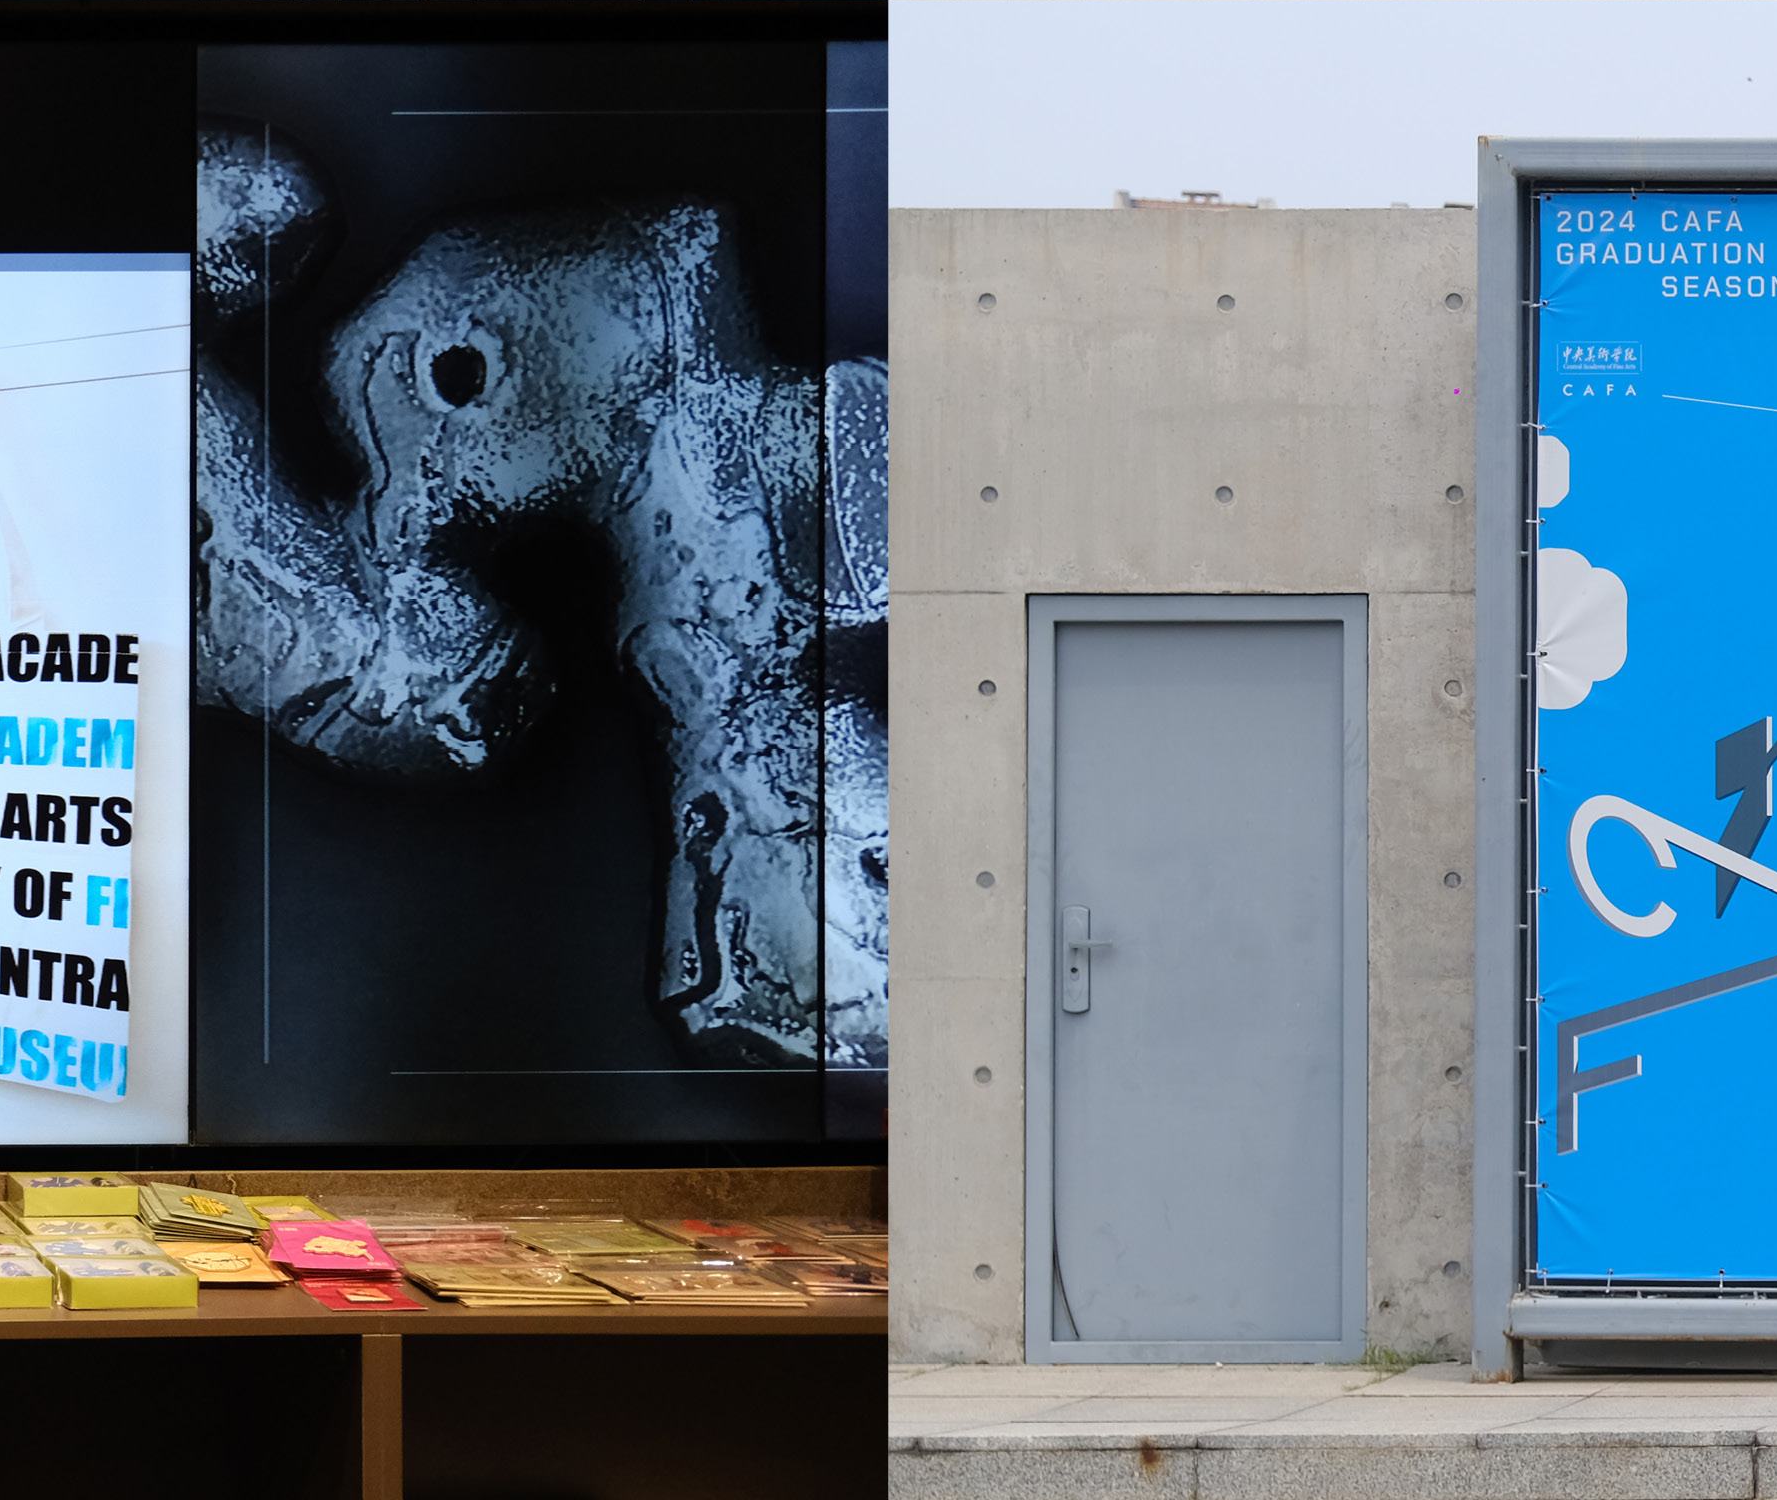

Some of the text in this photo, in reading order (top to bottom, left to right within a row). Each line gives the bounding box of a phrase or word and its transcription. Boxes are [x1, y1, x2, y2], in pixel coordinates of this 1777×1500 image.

[1556, 211, 1743, 232] 2024 CAFA
[1556, 243, 1765, 265] GRADUATION
[1563, 384, 1637, 396] CAFA
[0, 793, 133, 848] ARTS
[14, 868, 73, 921] OF
